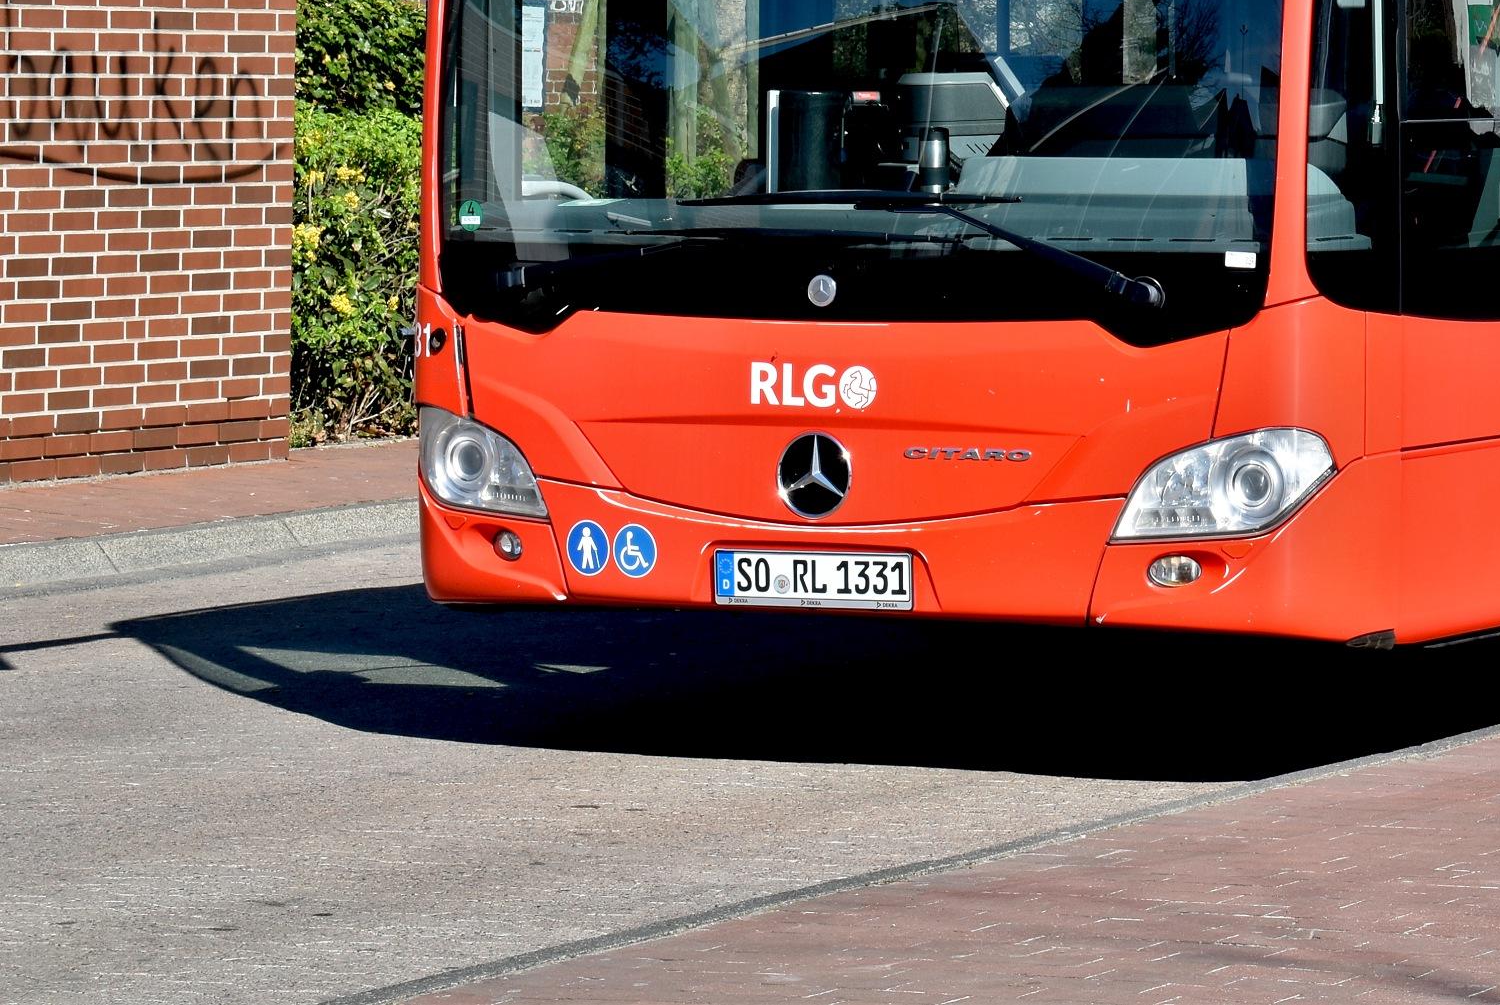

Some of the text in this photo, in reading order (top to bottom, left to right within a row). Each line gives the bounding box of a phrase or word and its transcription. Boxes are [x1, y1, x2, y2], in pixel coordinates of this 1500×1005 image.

[467, 201, 475, 217] 4
[750, 361, 837, 408] RLG
[904, 446, 1032, 463] CITARO
[722, 578, 731, 590] D
[737, 557, 907, 596] SO RL 1331
